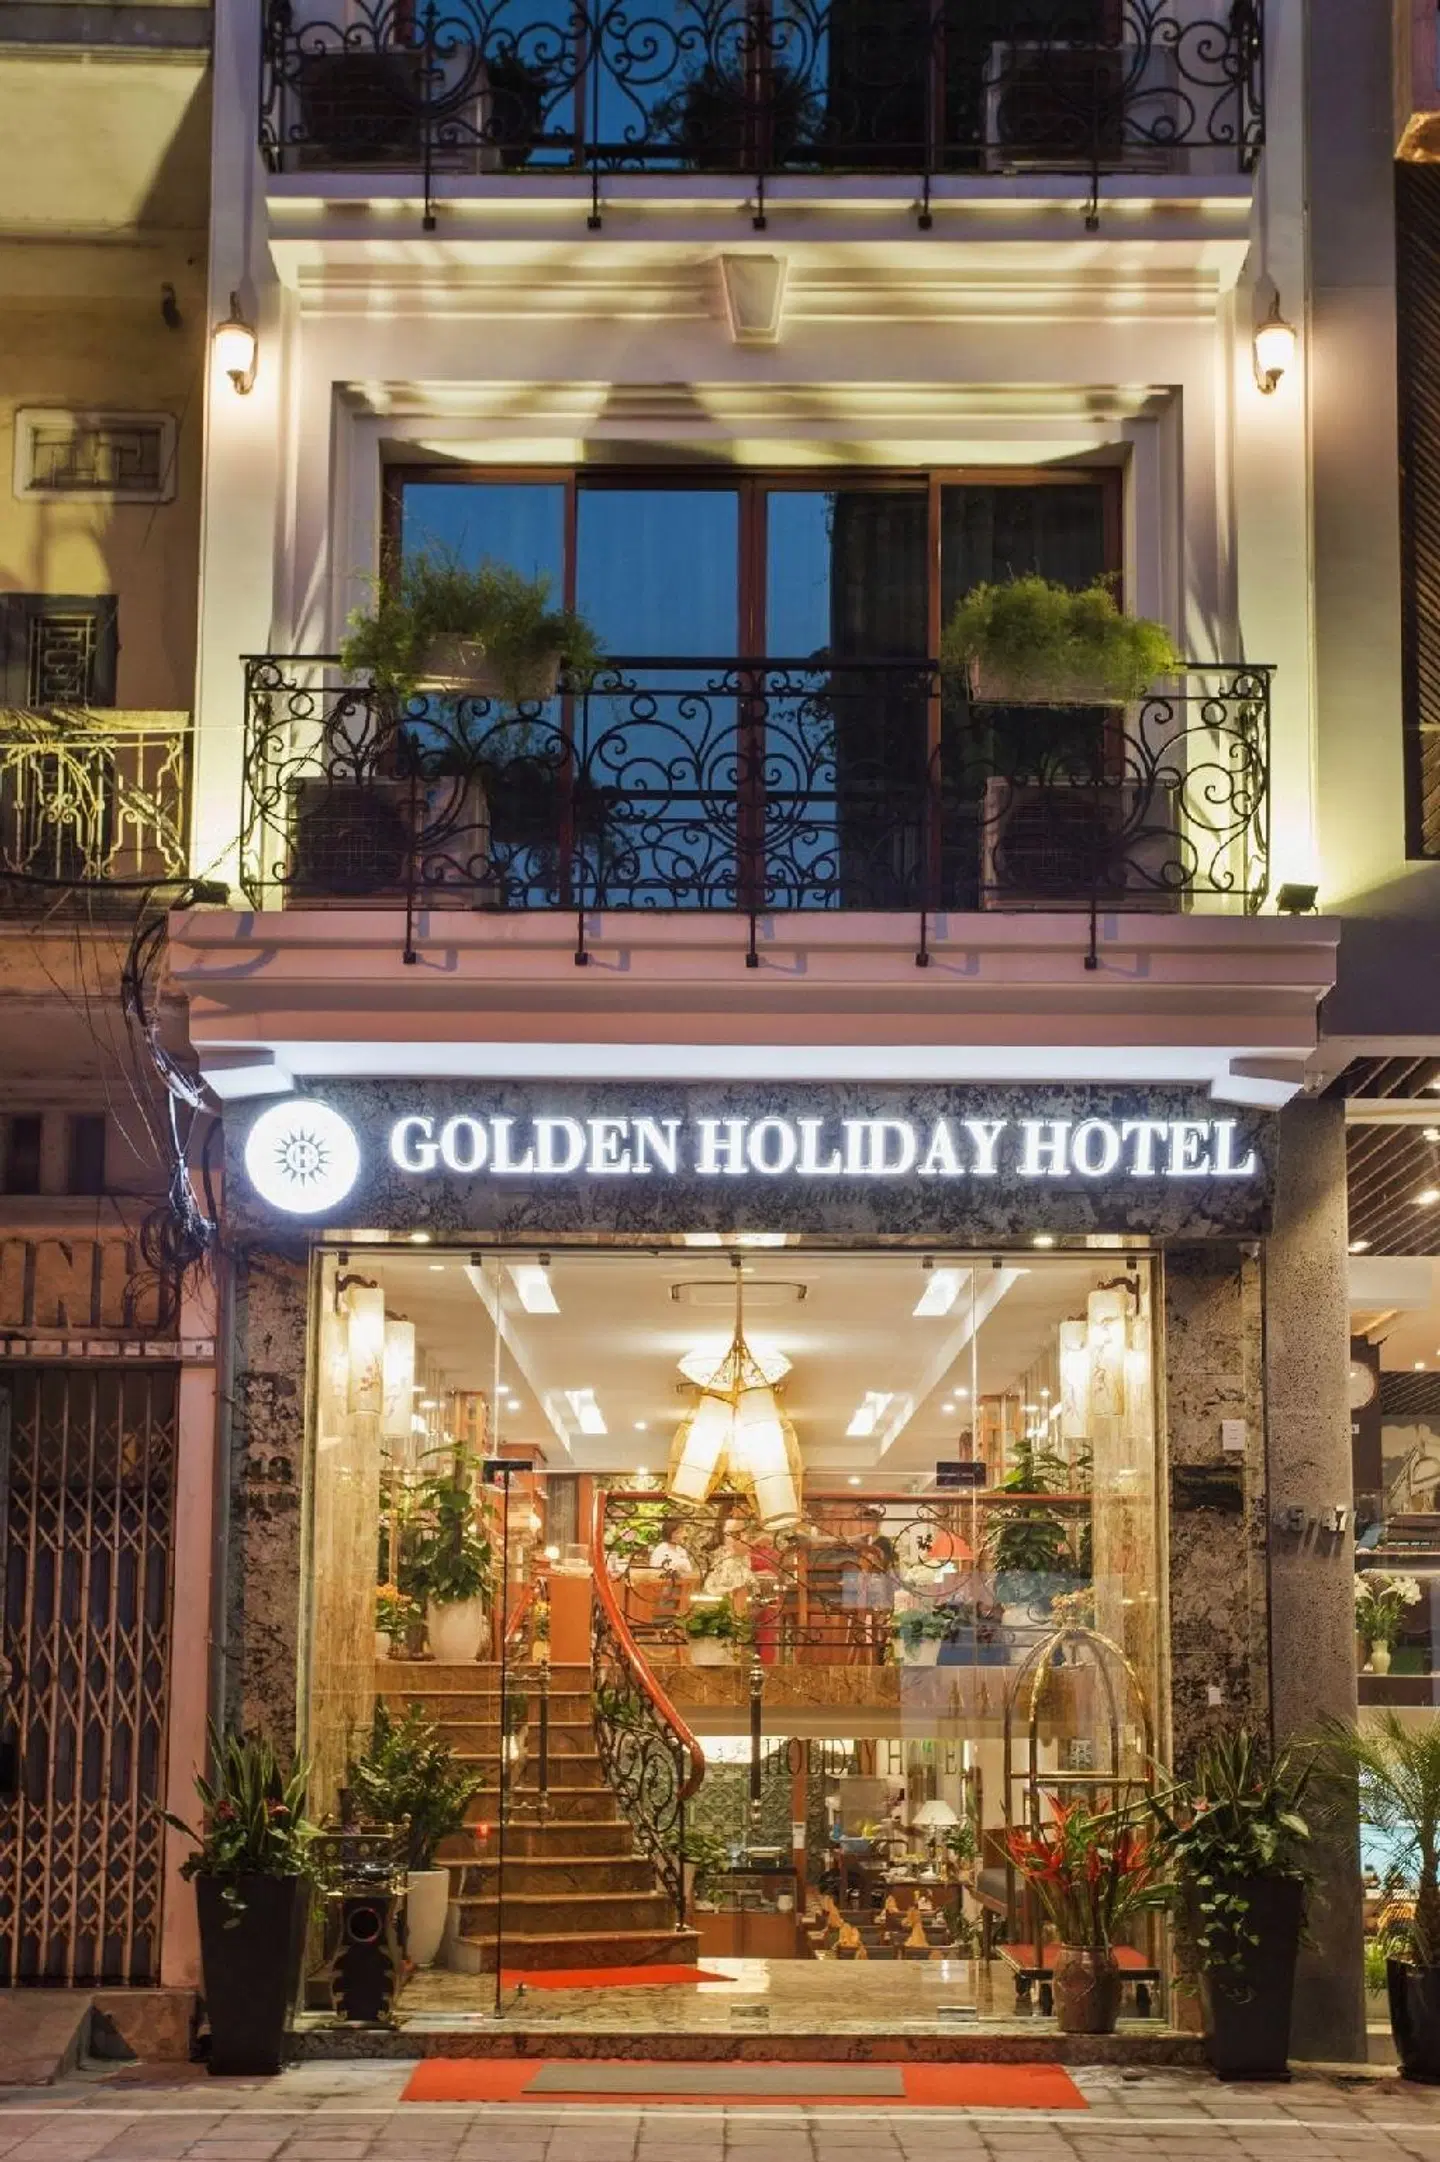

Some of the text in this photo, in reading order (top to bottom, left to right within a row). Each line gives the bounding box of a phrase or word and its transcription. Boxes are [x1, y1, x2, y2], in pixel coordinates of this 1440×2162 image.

[390, 1116, 1256, 1176] GOLDEN HOLIDAY HOTEL
[764, 1738, 877, 1774] HOLIDY
